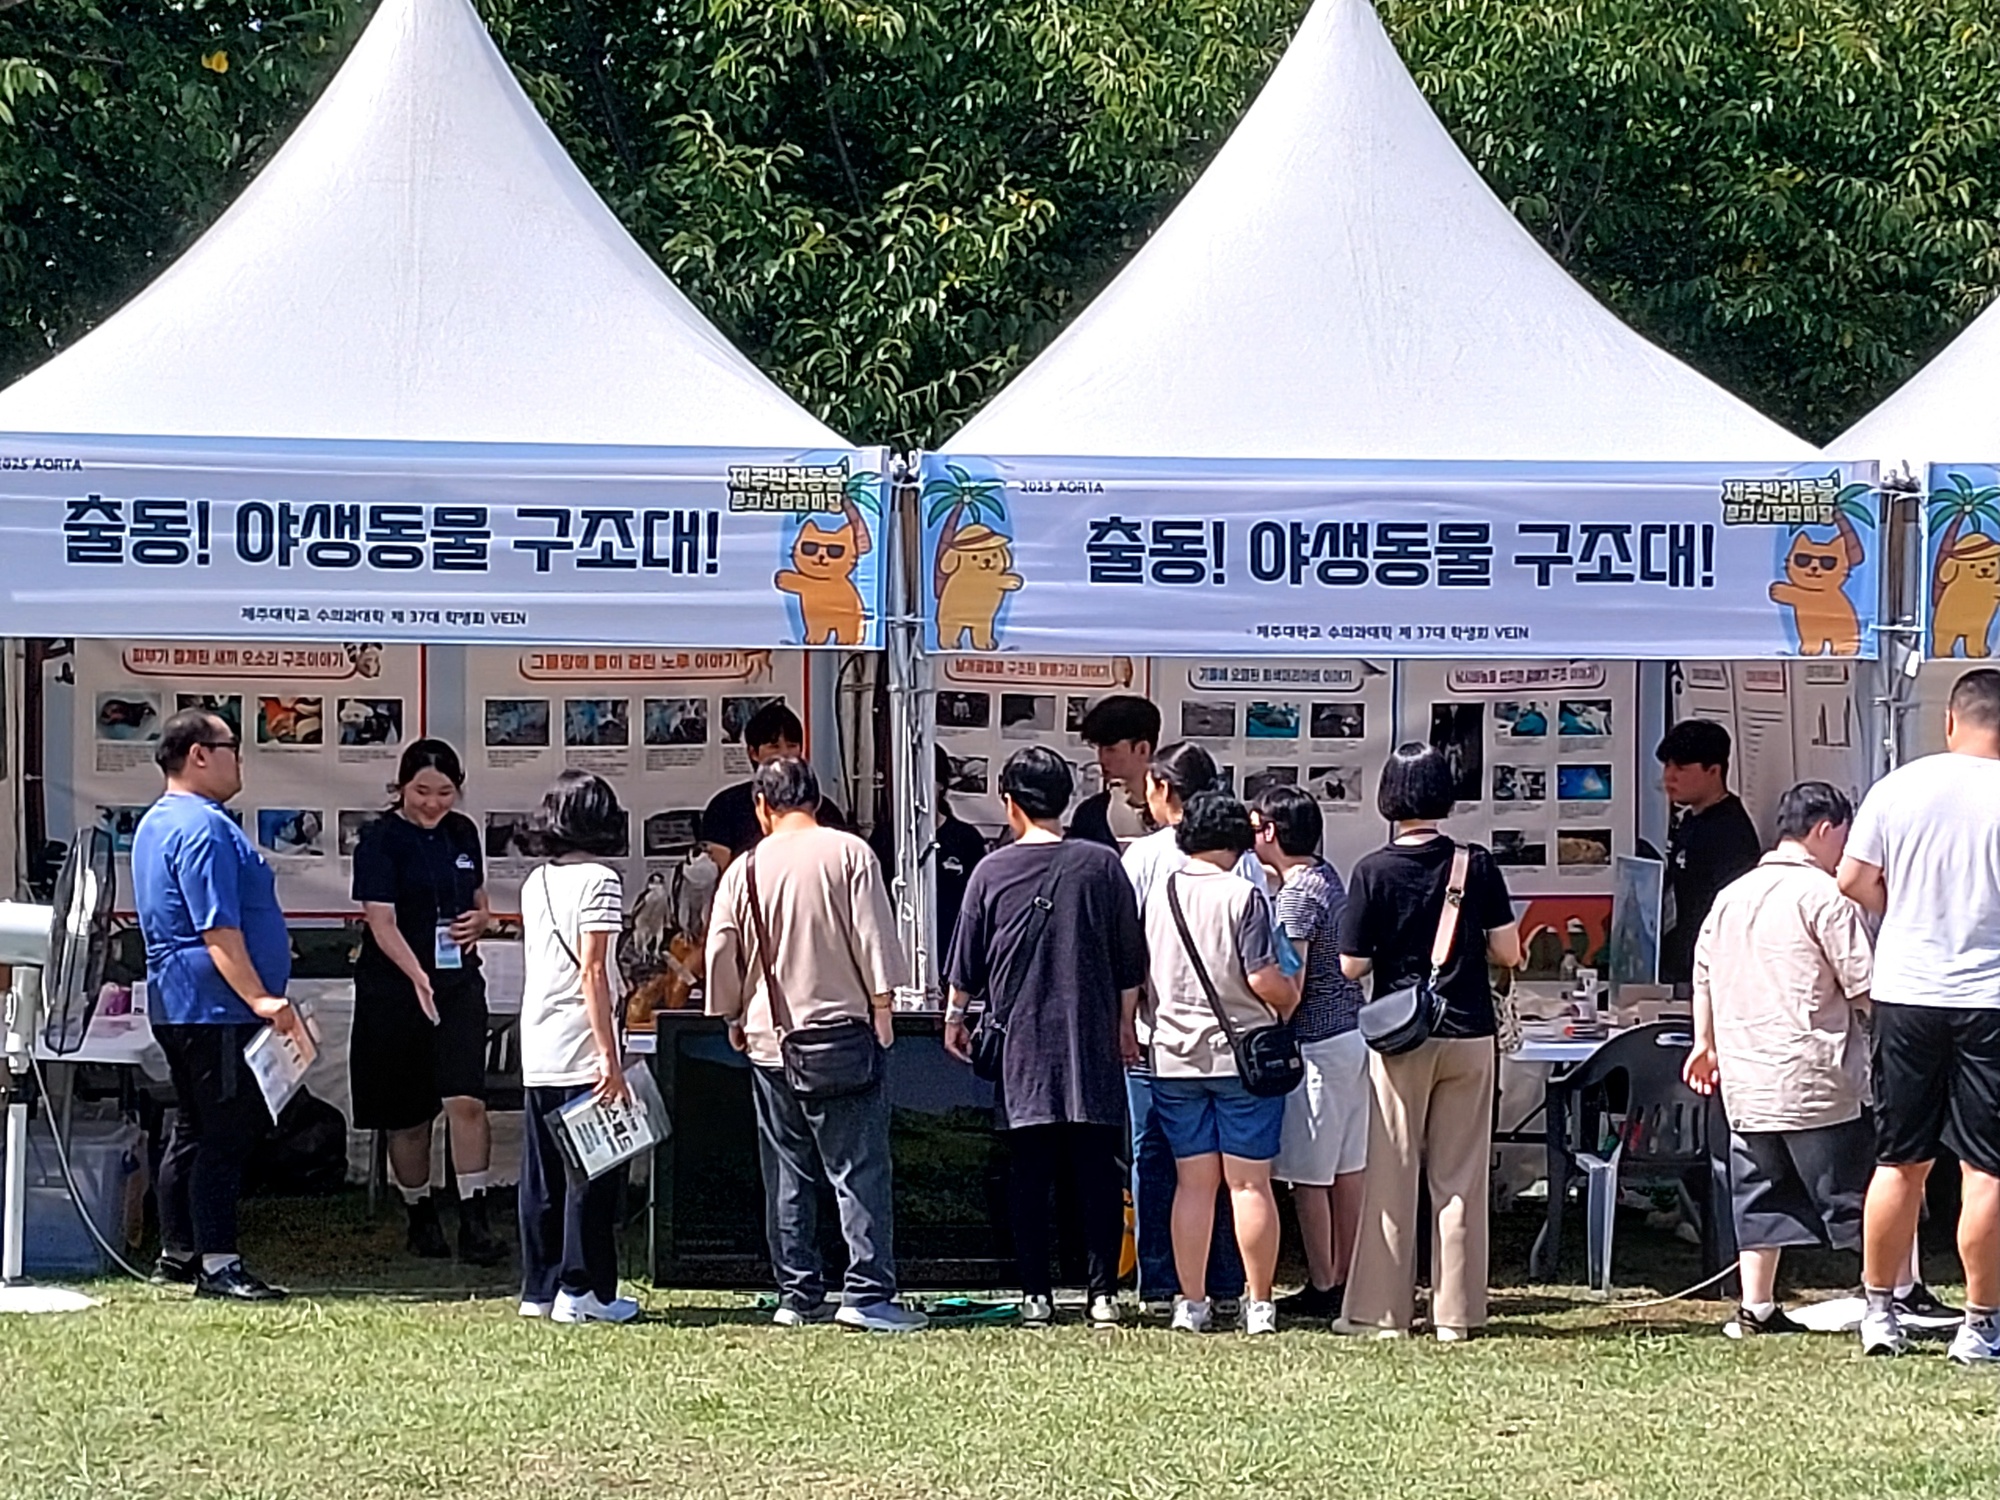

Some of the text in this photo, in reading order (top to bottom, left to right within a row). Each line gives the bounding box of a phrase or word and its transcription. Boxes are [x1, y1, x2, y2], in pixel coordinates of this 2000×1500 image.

[0, 458, 83, 471] 025 AORTA
[1020, 481, 1105, 493] 2025 AORTA
[1724, 479, 1836, 504] 제주반려동물
[64, 494, 720, 574] 출동! 야생동물 구조대!
[1087, 517, 1715, 587] 출동! 야생동물 구조대!
[241, 607, 527, 625] 제주대학교 수의과대학 제 37대 학생회 VEIN
[1256, 625, 1530, 641] 제주대학교 수의과대학 제 37대 학생회 VEIN
[242, 650, 278, 667] 오소리
[282, 651, 344, 668] 구조이야기
[661, 654, 690, 669] 노루
[696, 653, 738, 669] 이야기
